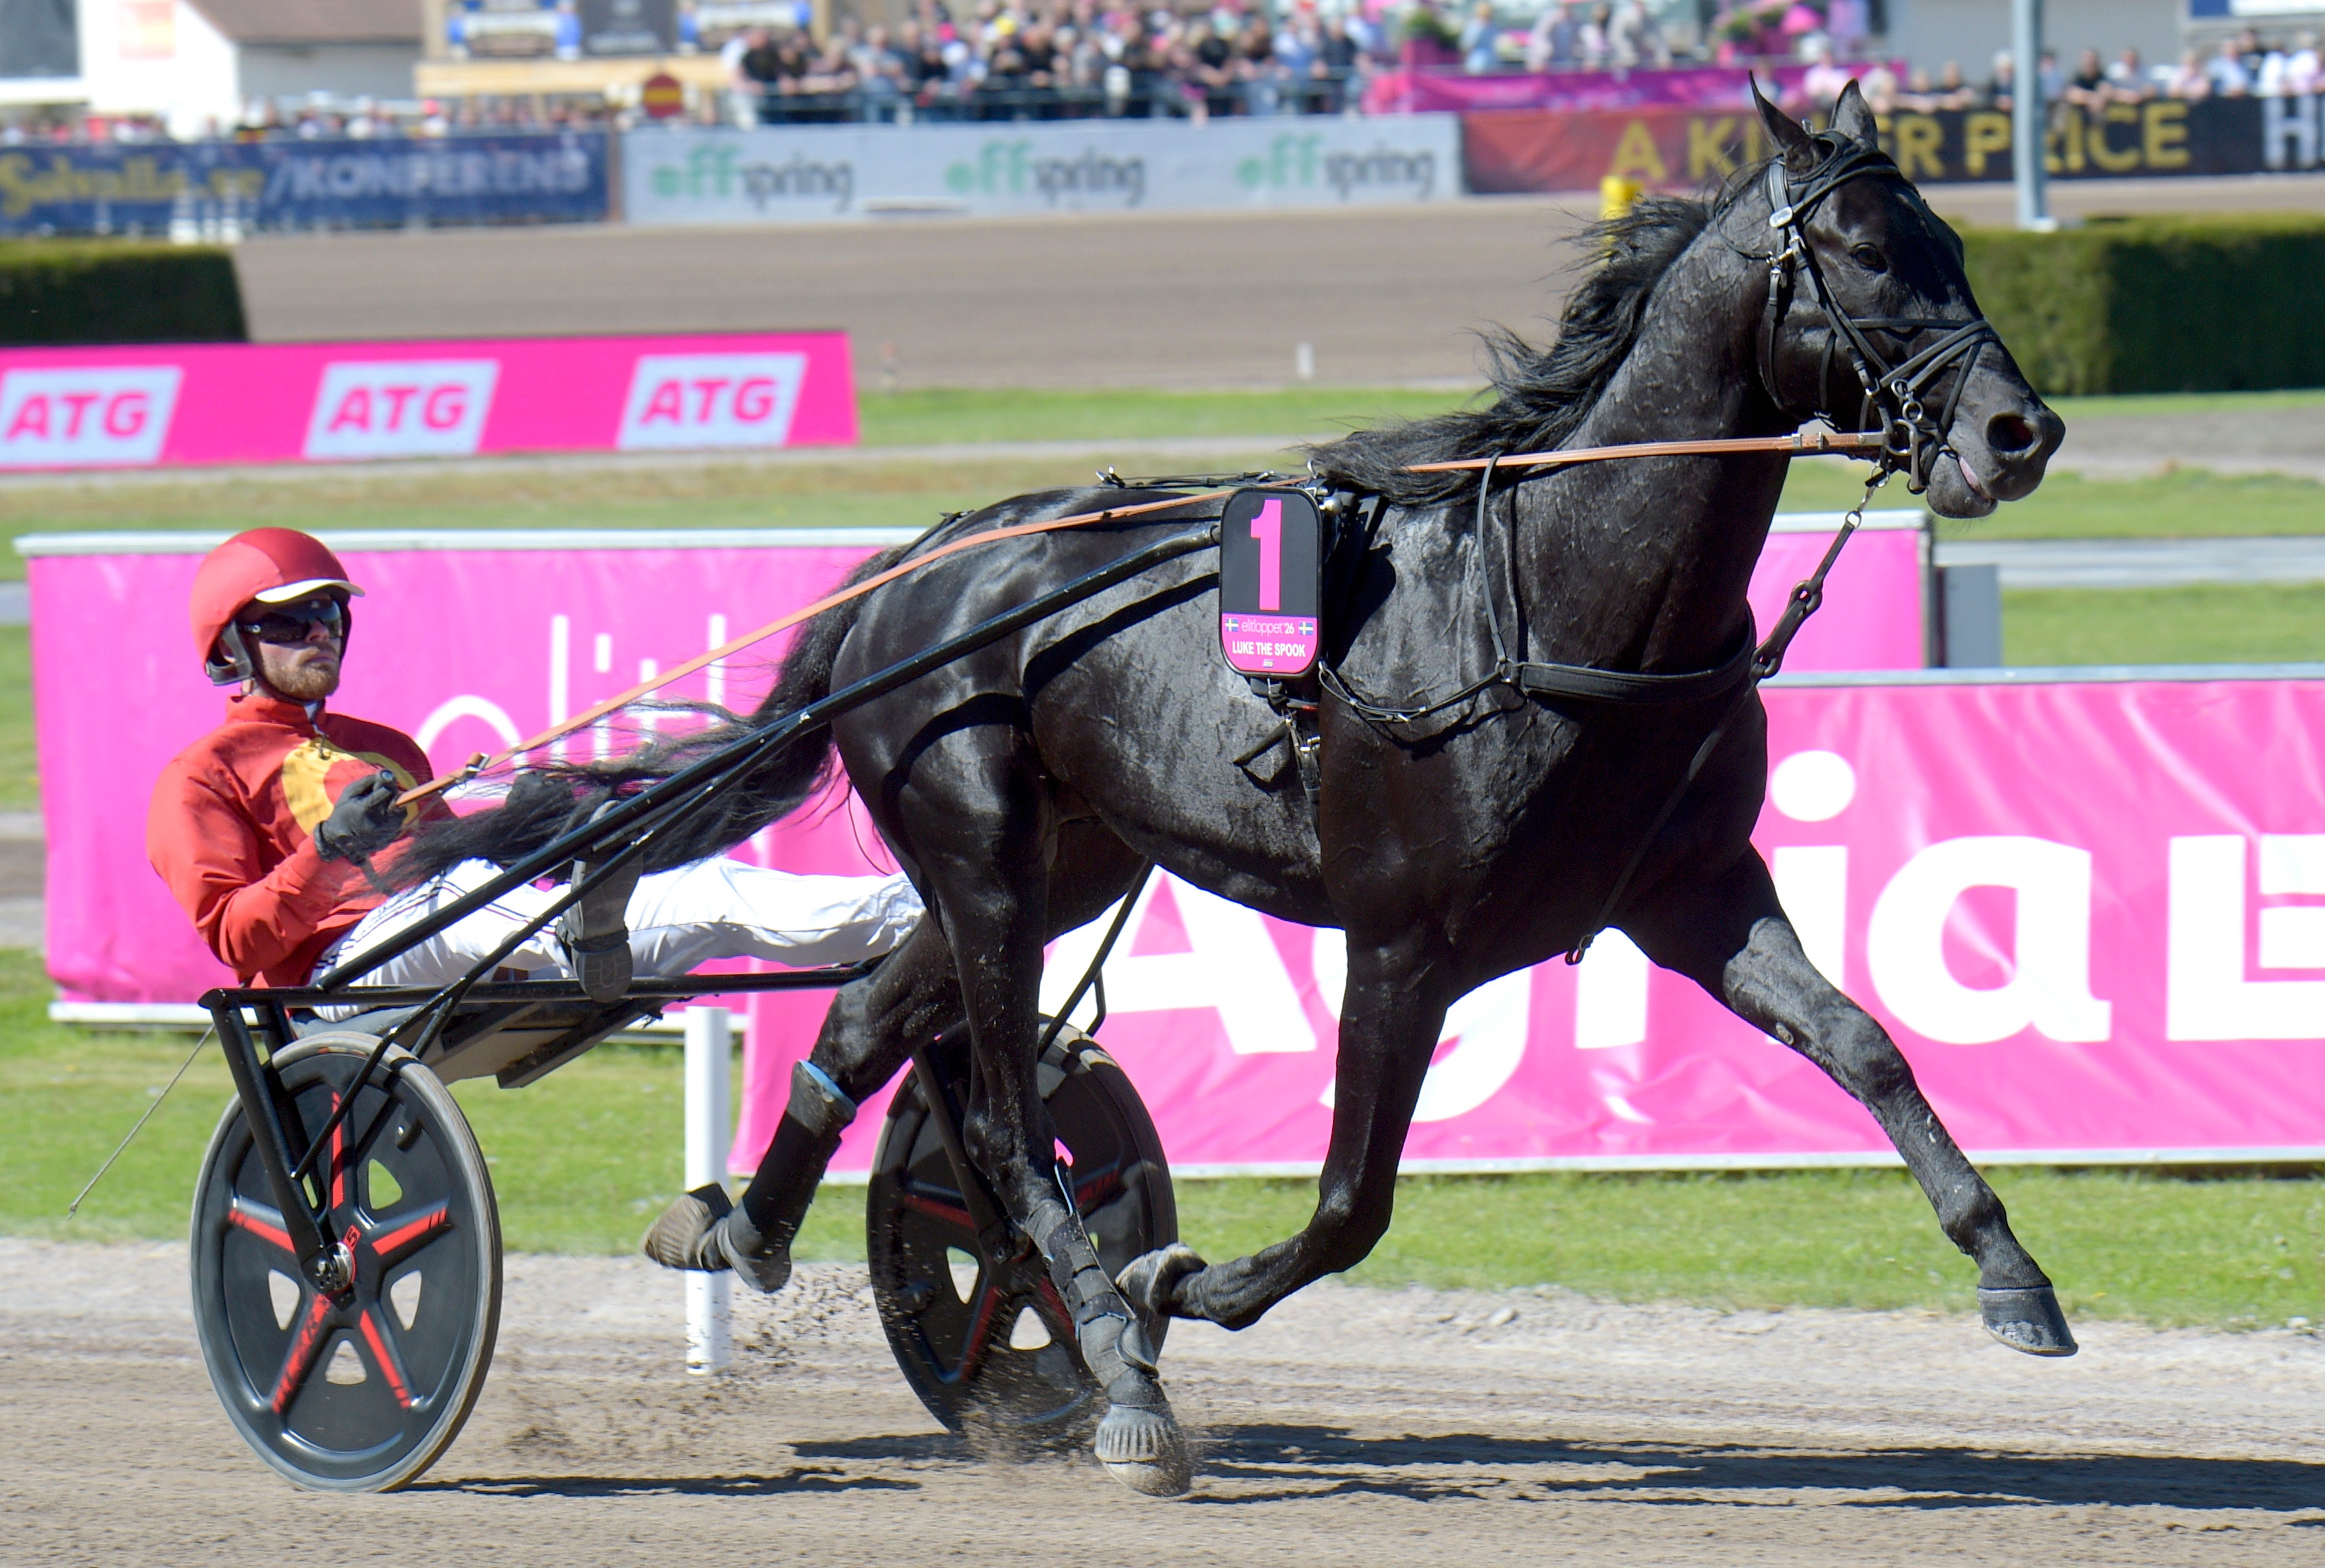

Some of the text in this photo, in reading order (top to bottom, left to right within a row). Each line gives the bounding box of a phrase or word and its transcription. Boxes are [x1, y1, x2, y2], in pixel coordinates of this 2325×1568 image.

[1609, 119, 1668, 183] A
[5, 390, 150, 442] ATG
[328, 382, 470, 434] ATG
[638, 376, 778, 426] ATG
[1250, 499, 1282, 611] 1
[1232, 640, 1306, 657] LUKE THE SPOOK
